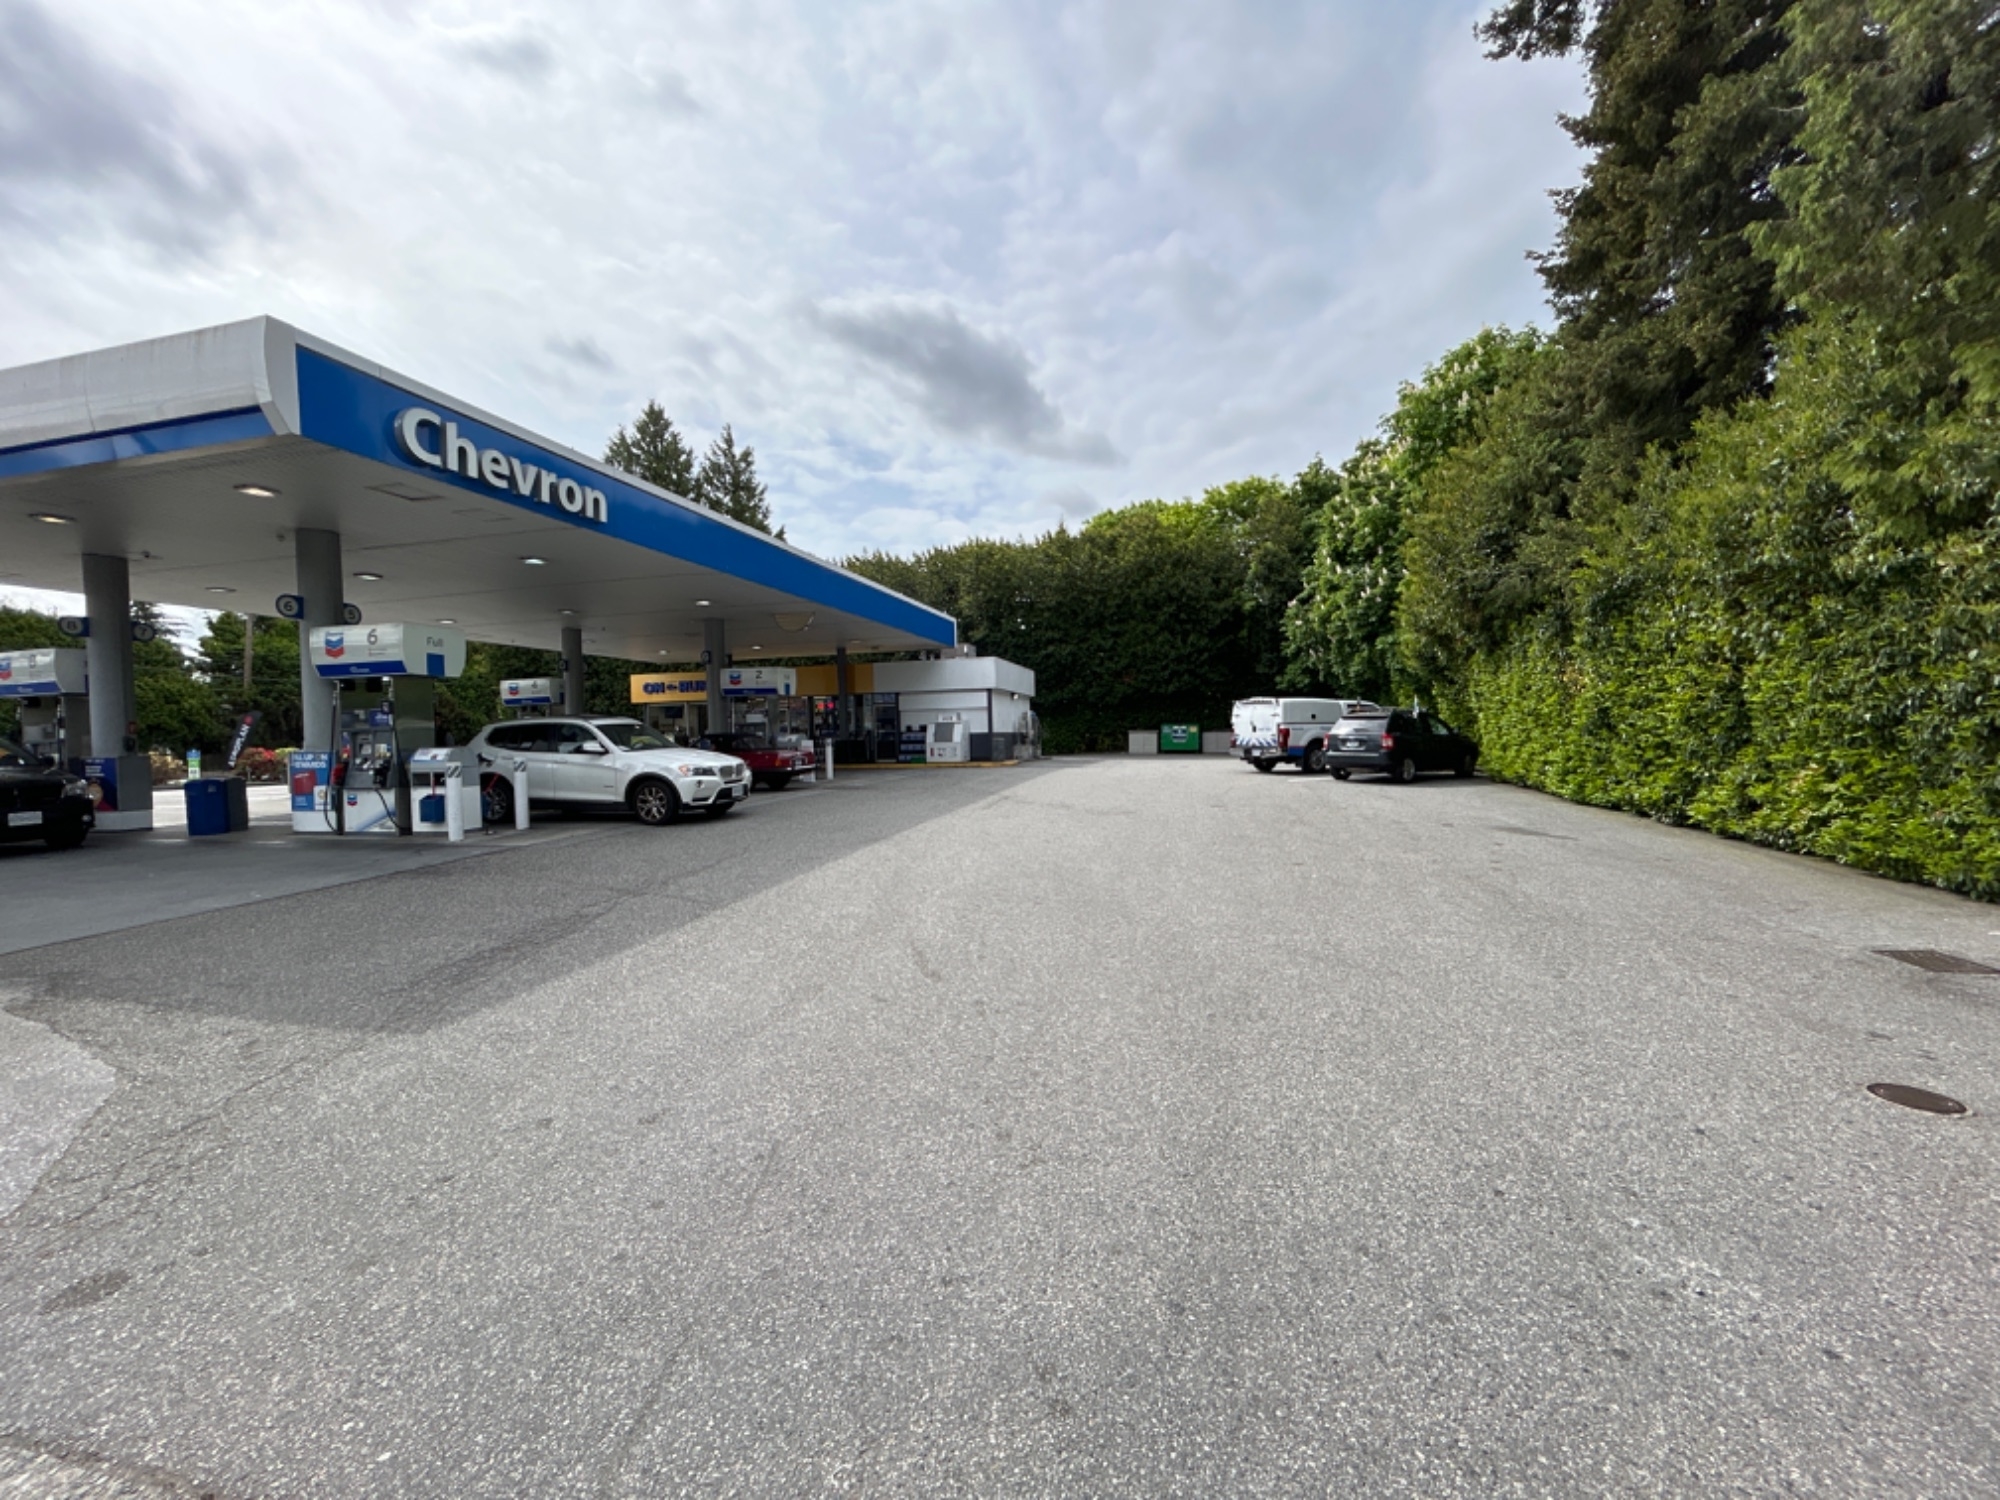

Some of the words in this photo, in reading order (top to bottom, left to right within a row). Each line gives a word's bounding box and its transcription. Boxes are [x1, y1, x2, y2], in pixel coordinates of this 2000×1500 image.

[396, 407, 608, 523] Chevron
[366, 627, 378, 646] 6
[426, 636, 444, 648] Full
[755, 669, 763, 679] 2
